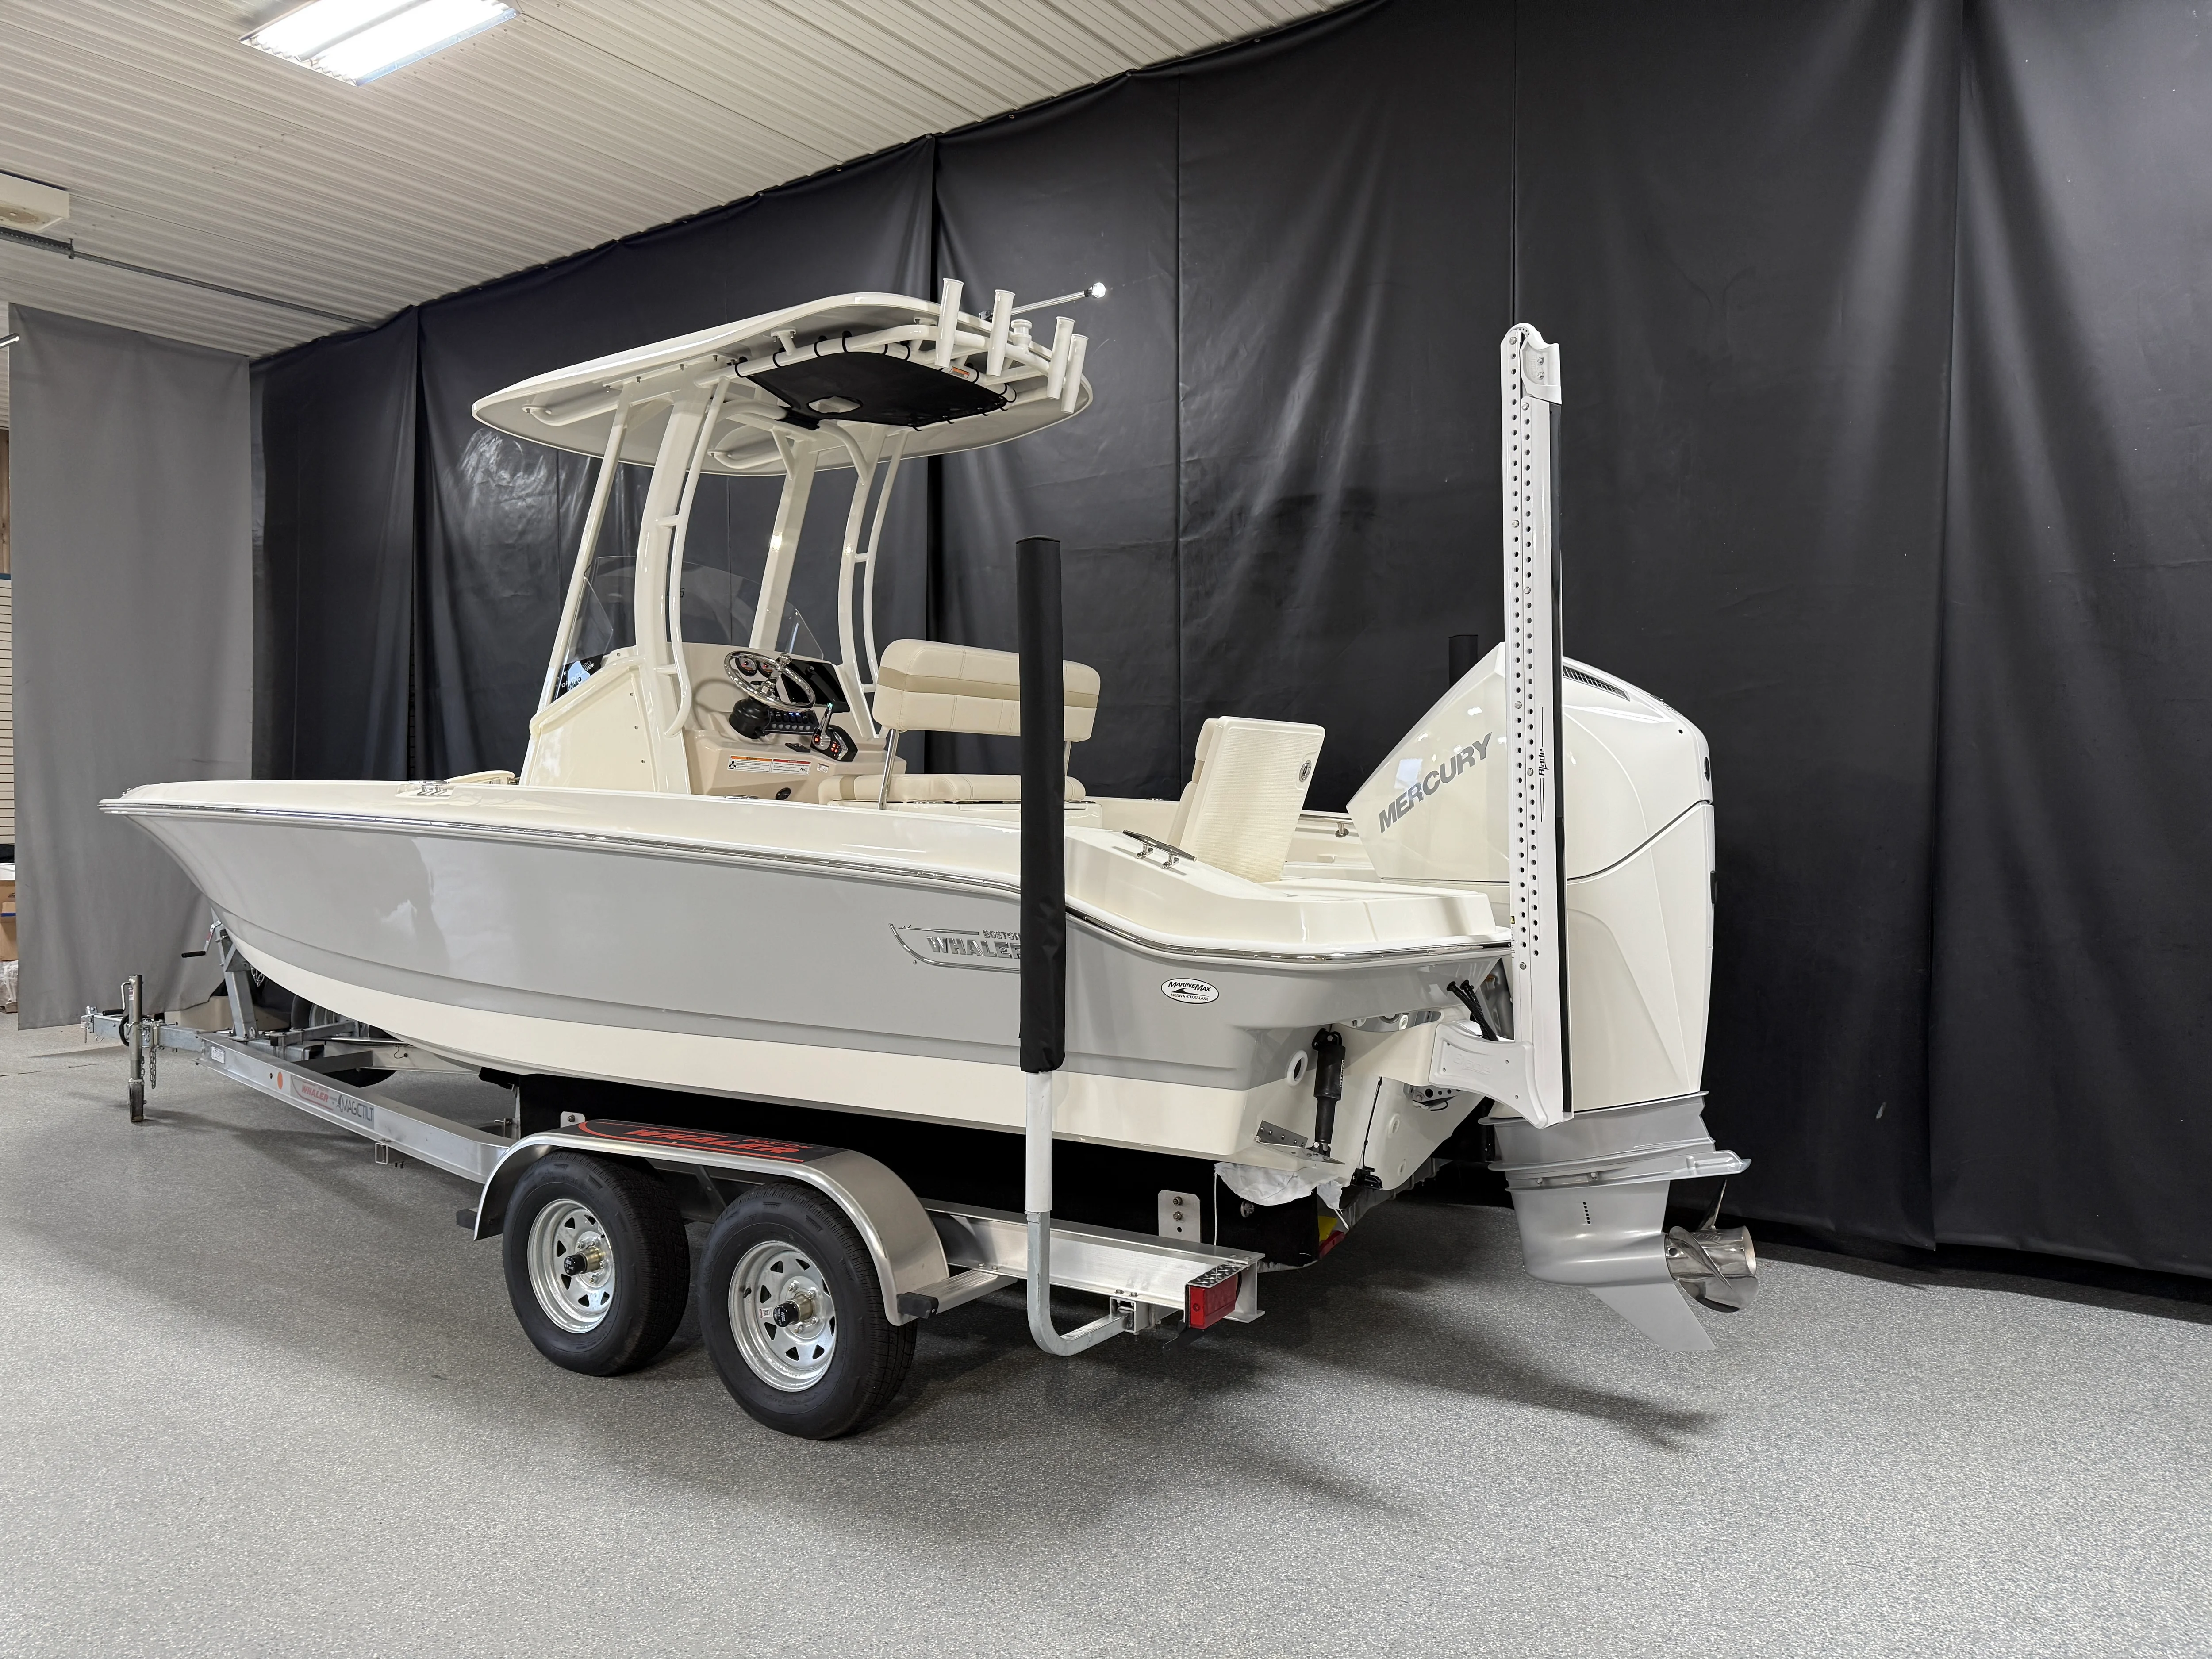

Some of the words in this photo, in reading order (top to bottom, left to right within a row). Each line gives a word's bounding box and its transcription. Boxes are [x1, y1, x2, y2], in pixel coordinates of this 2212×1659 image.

[1539, 749, 1549, 776] Blade
[1379, 732, 1492, 833] MERCURY
[983, 929, 1021, 941] BOSTON
[302, 1085, 329, 1103] WHALER
